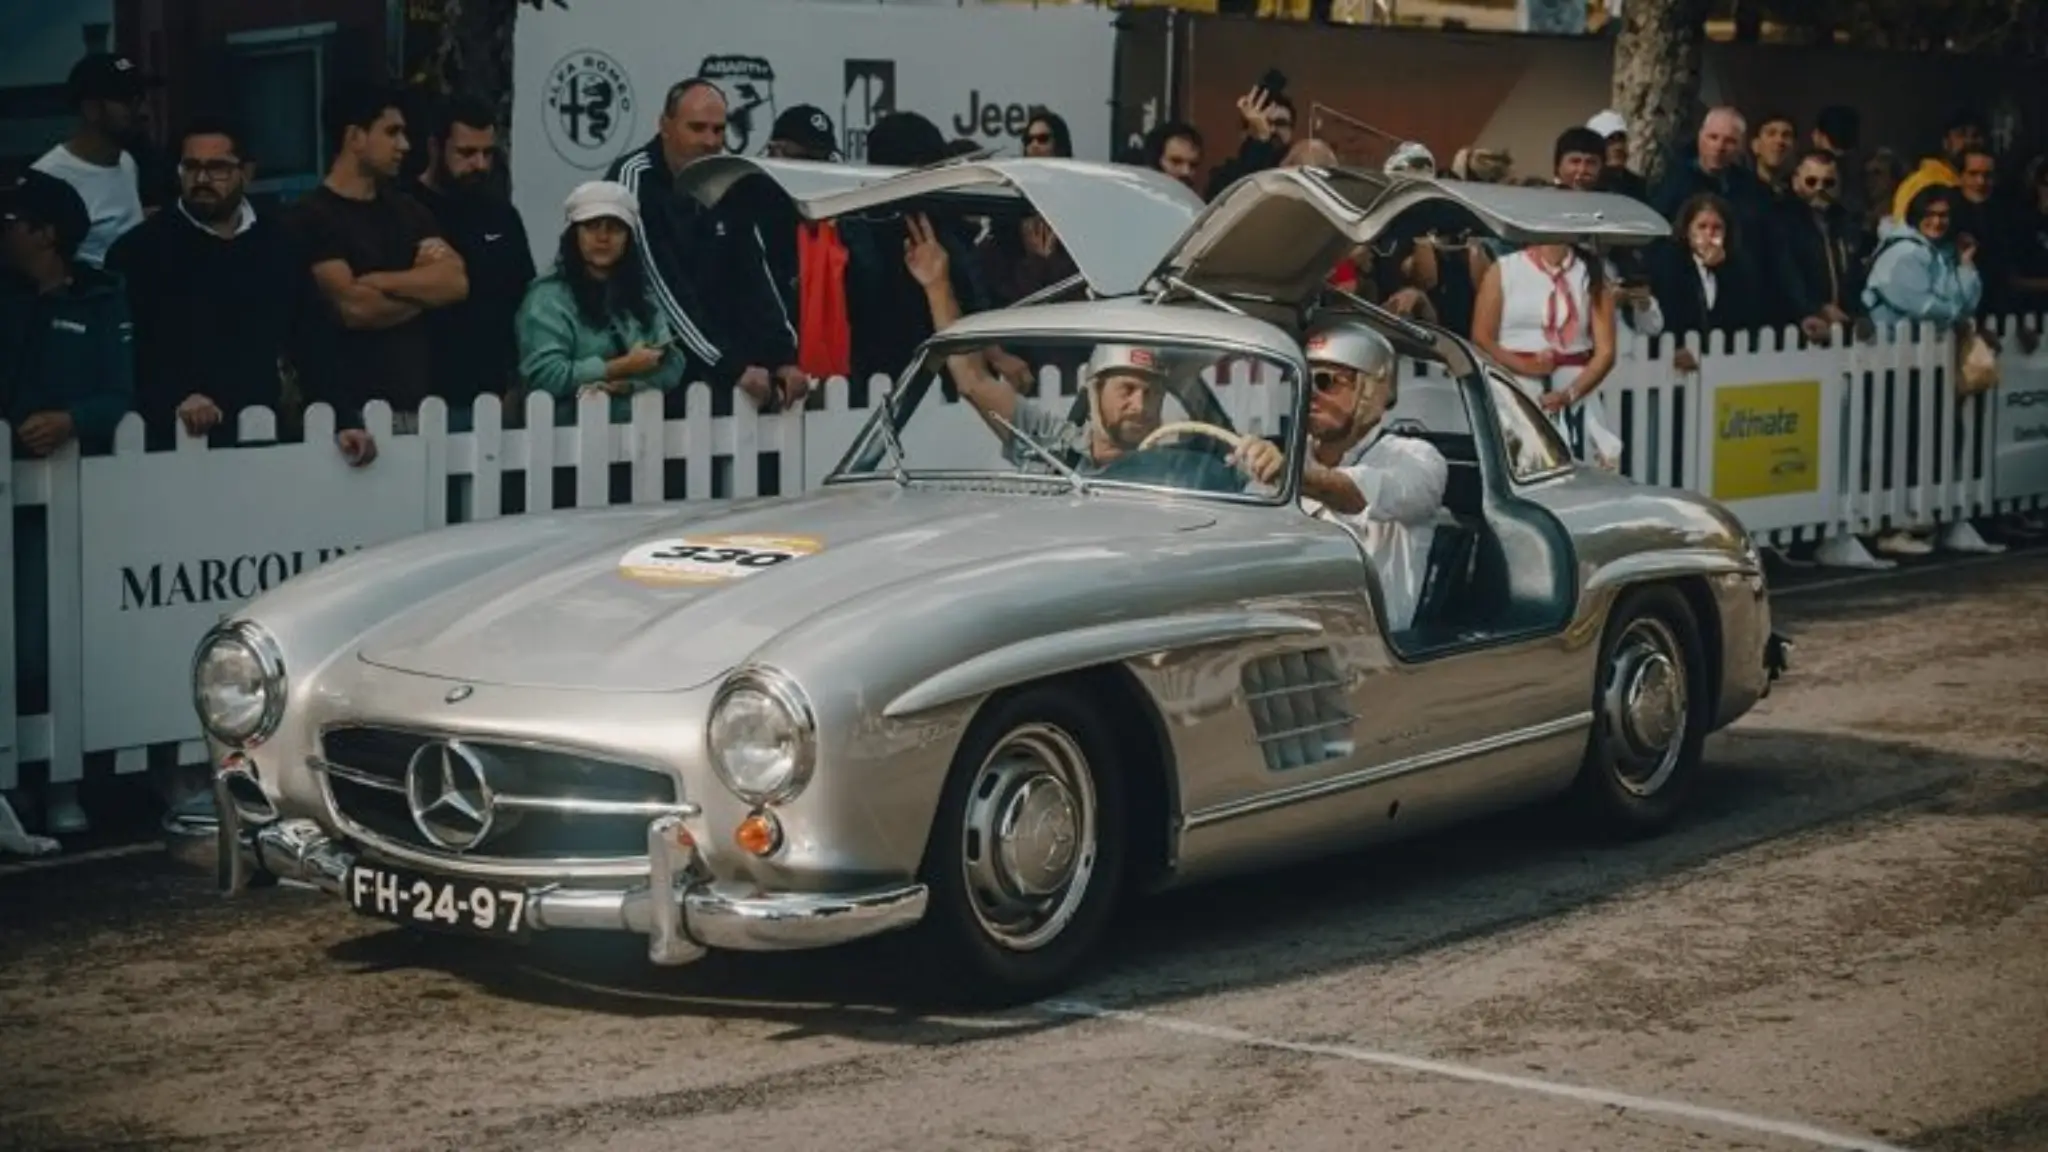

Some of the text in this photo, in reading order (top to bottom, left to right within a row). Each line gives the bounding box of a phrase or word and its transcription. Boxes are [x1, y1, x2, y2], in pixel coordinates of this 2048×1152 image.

[548, 56, 630, 113] ALFA ROMEO
[119, 545, 363, 611] MARCO
[652, 546, 793, 567] 330
[353, 866, 525, 933] FH-24-97
